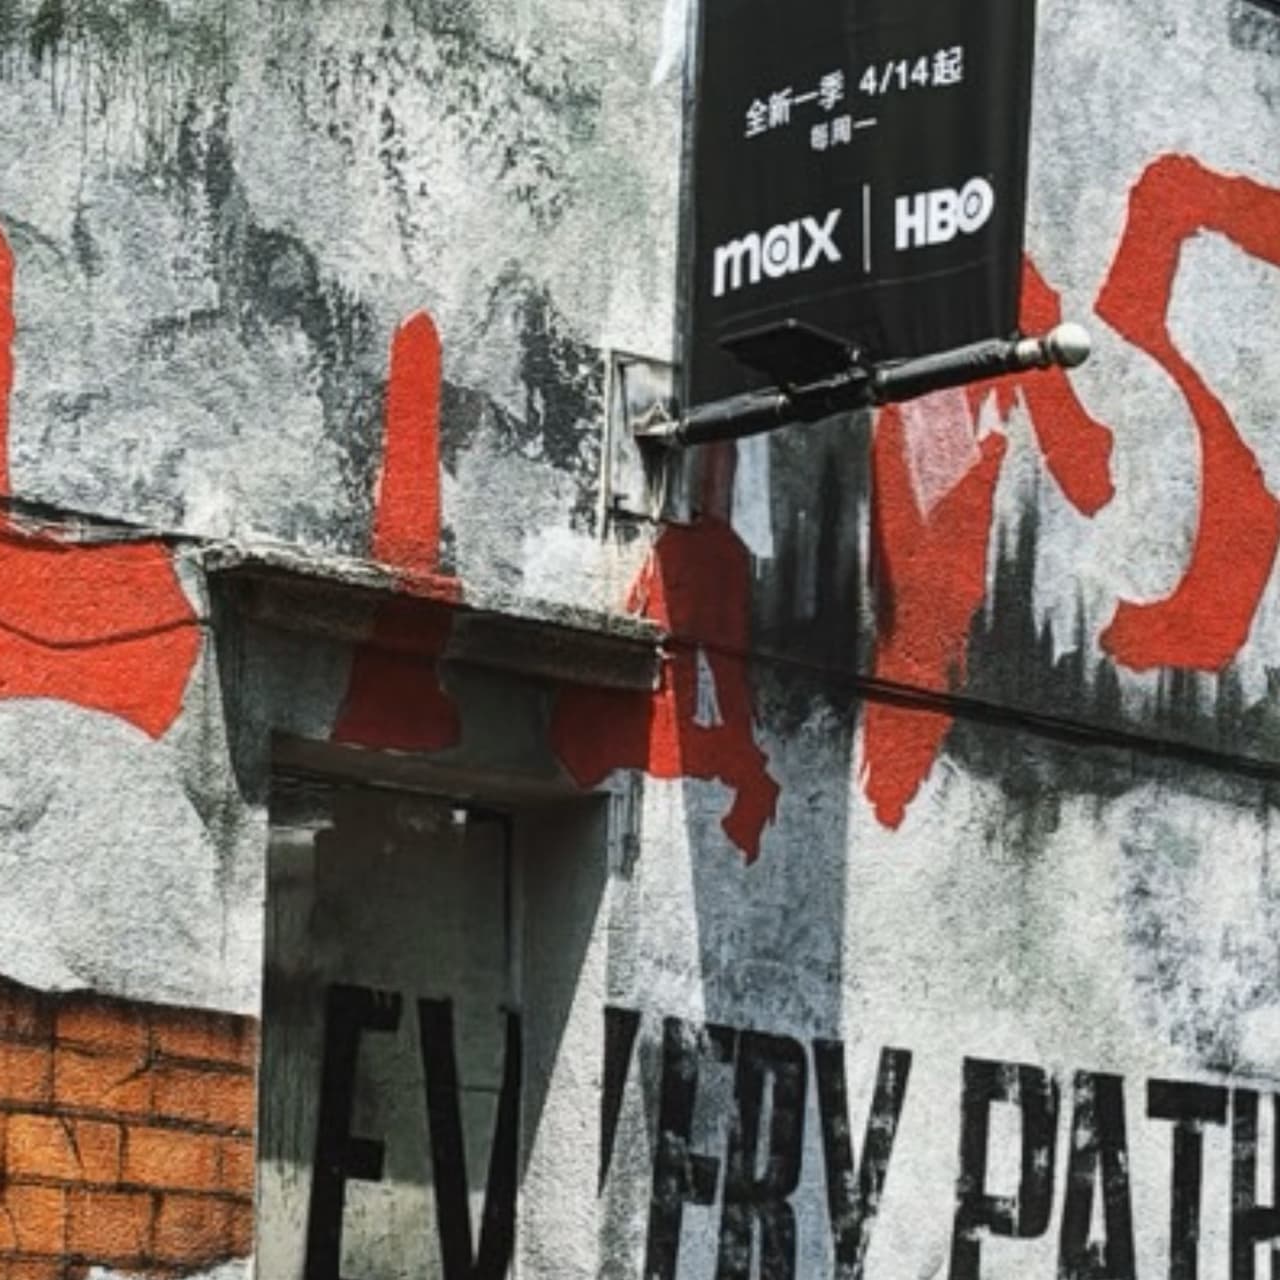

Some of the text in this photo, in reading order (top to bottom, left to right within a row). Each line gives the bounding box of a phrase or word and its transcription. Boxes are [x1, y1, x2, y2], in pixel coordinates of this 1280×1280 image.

[744, 46, 963, 138] 全新一季 4/14起
[713, 208, 841, 297] max
[894, 177, 994, 250] HBO
